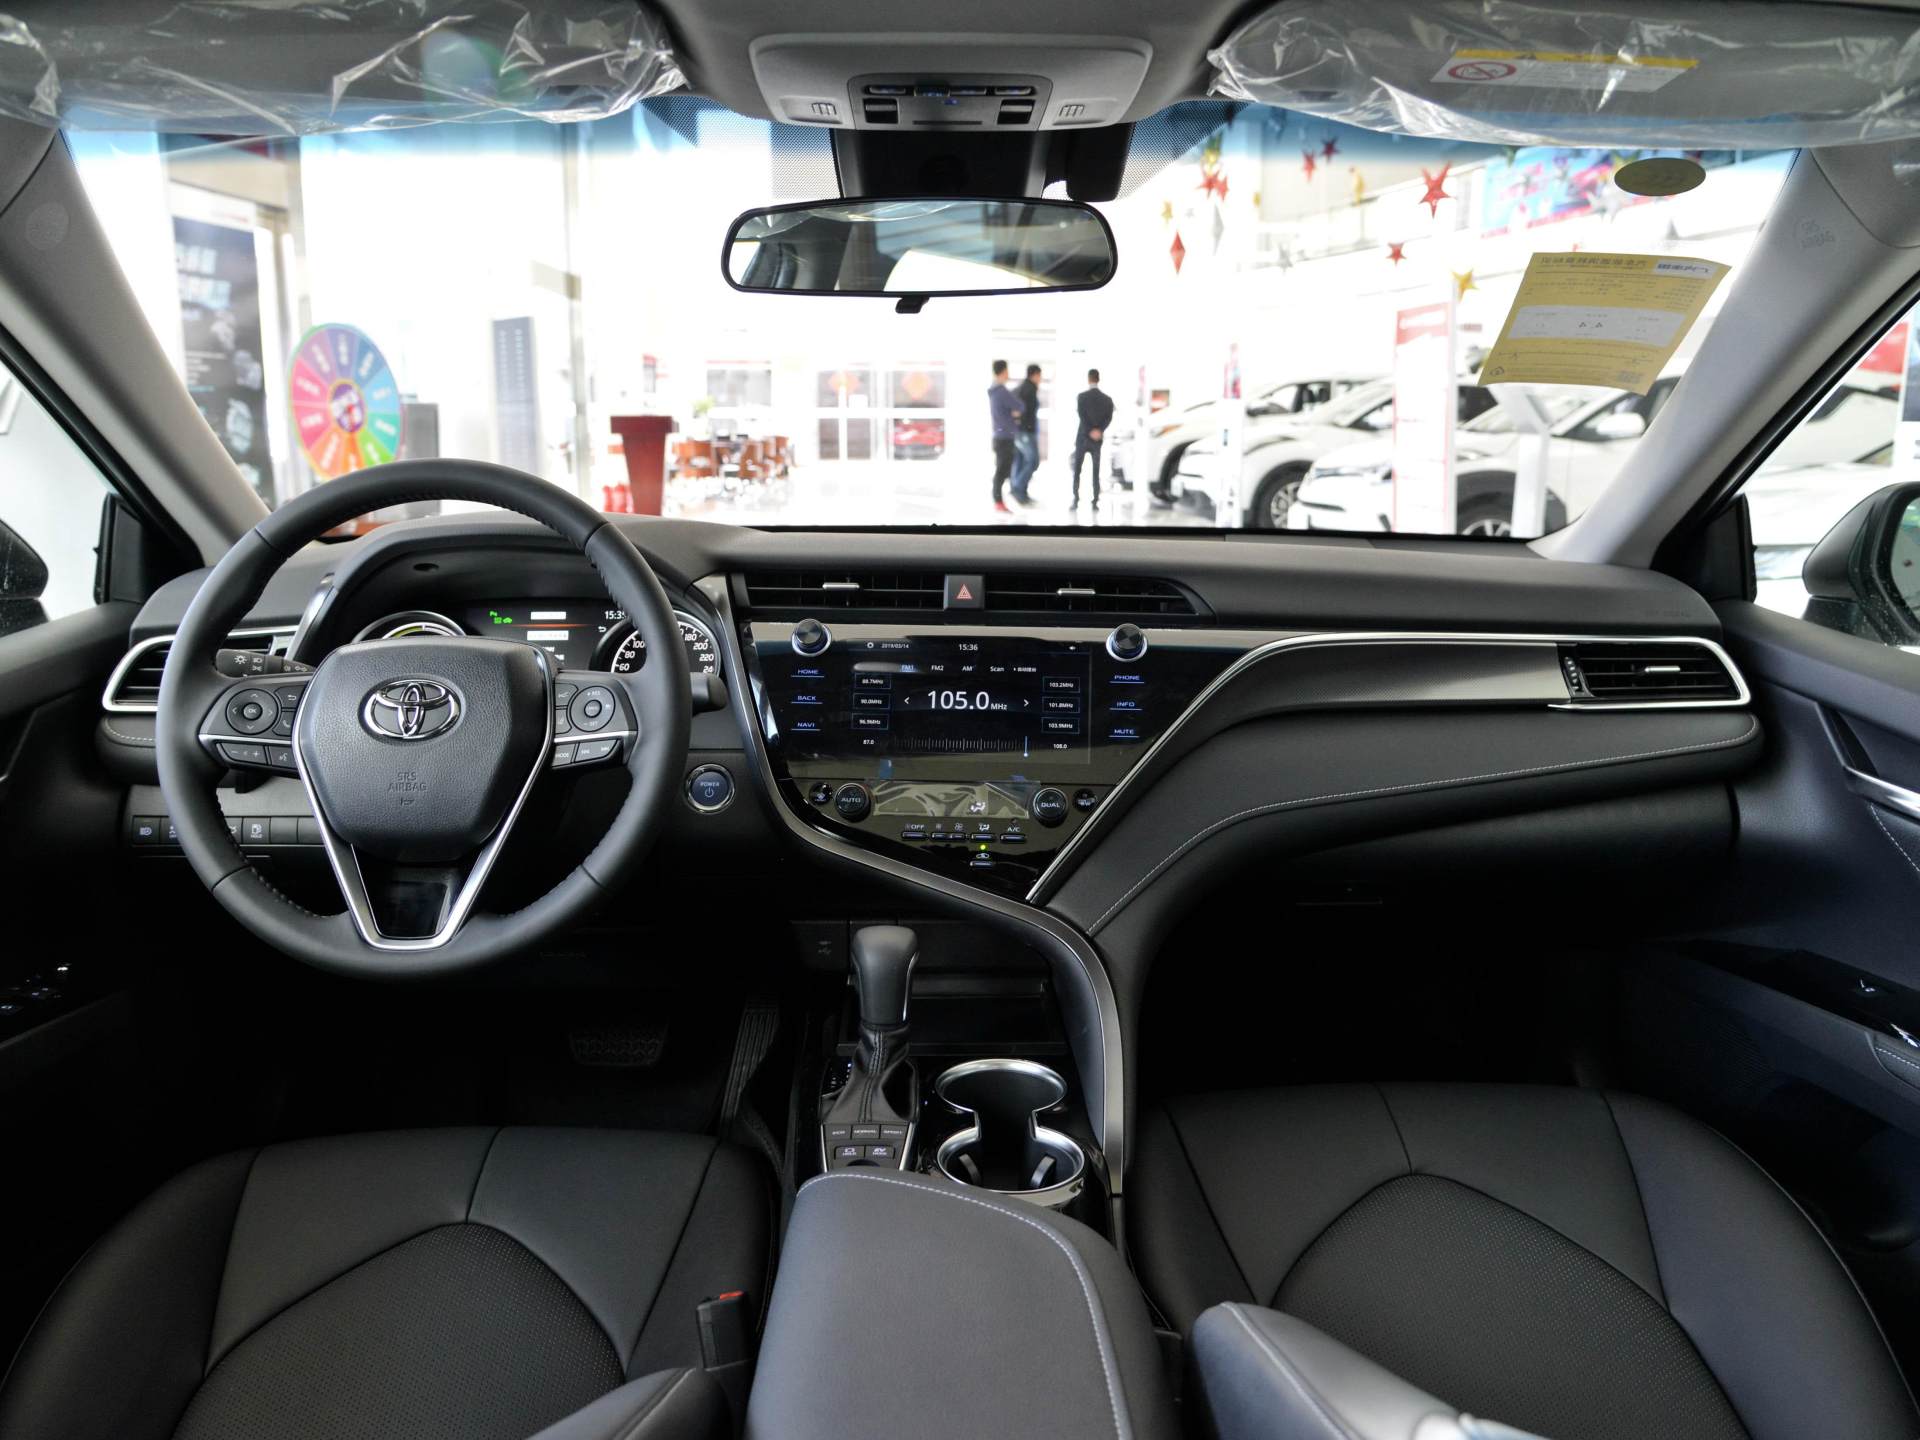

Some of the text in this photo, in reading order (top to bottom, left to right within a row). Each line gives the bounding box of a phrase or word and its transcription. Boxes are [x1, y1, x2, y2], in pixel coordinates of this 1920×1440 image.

[684, 633, 697, 641] 180
[632, 640, 645, 648] 100
[692, 642, 708, 650] 200
[959, 643, 978, 651] 15:36
[624, 650, 635, 658] 80
[699, 653, 714, 661] 220
[619, 663, 630, 671] 60
[928, 690, 989, 710] 105.0
